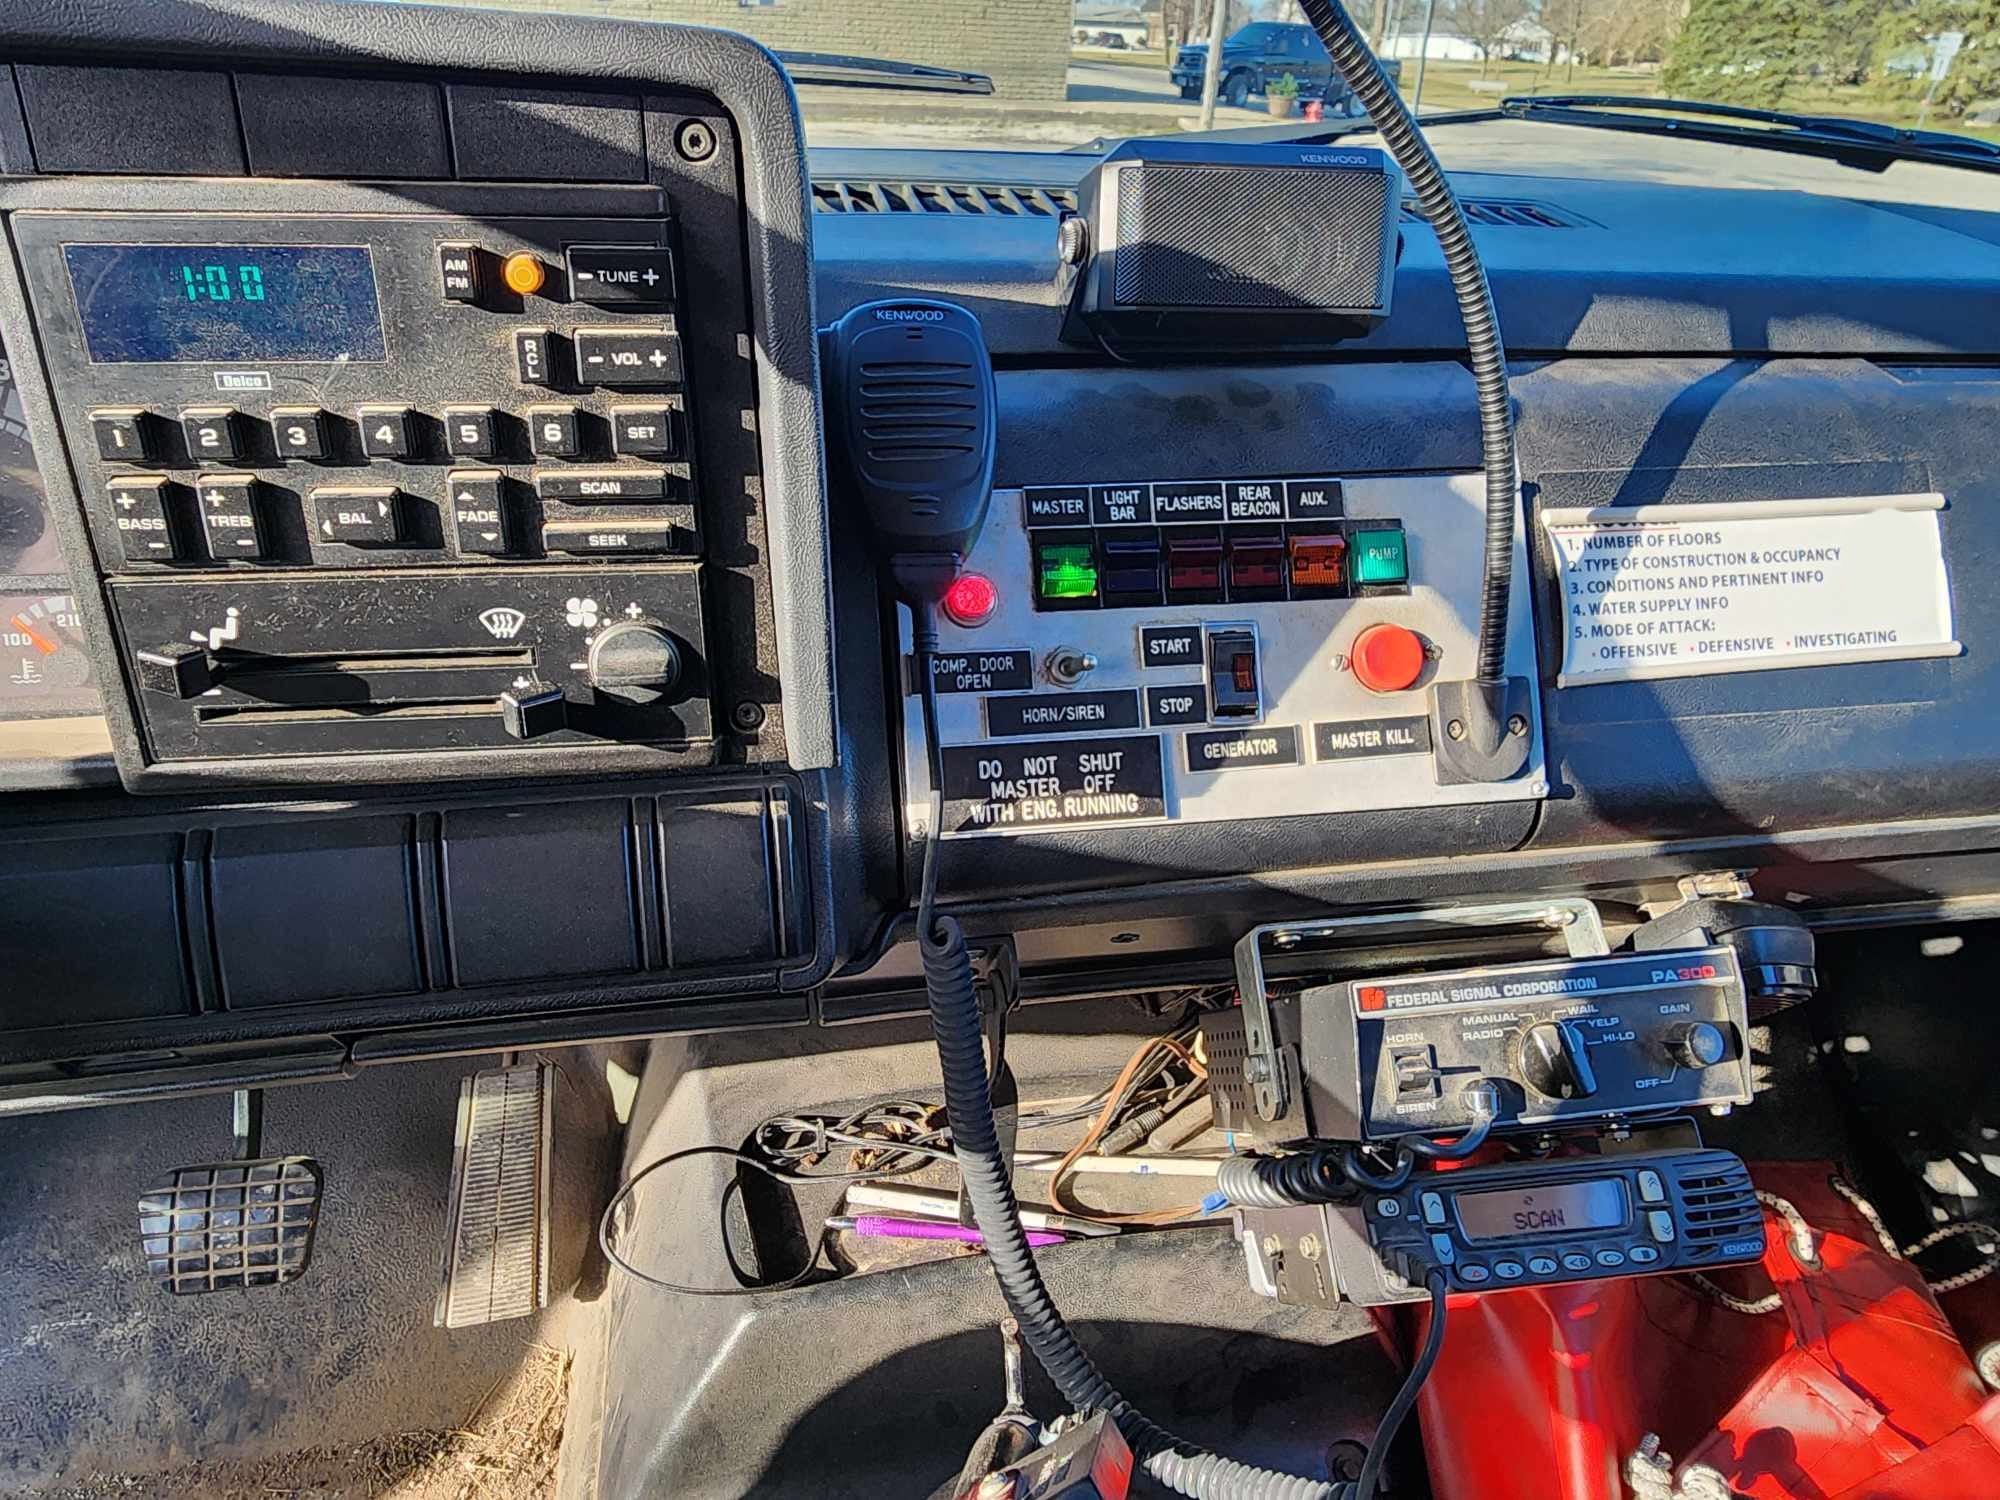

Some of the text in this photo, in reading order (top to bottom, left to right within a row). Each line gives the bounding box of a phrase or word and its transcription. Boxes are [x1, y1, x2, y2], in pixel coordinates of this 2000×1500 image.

[1301, 153, 1367, 165] KENWOOD
[445, 259, 468, 272] AM
[182, 265, 265, 301] 1:00
[447, 276, 469, 289] FM
[597, 269, 639, 283] TUNE
[876, 309, 944, 321] KENWOOD
[610, 352, 643, 366] VOL
[222, 375, 262, 387] Delco
[111, 429, 125, 448] 1
[199, 428, 220, 447] 2
[287, 426, 308, 446] 3
[375, 425, 394, 444] 4
[460, 424, 479, 443] 5
[544, 423, 563, 442] 6
[627, 426, 656, 440] SET
[580, 481, 621, 495] SCAN
[1238, 486, 1272, 501] REAR
[1104, 490, 1141, 506] LIGHT
[1156, 494, 1222, 512] FLASHERS
[1300, 490, 1329, 507] AUX.
[1032, 499, 1085, 516] MASTER
[1110, 504, 1136, 521] BAR
[1231, 499, 1281, 517] BEACON
[117, 518, 166, 531] BASS
[207, 515, 253, 529] TREB
[338, 512, 373, 526] BAL
[457, 510, 499, 523] FADE
[588, 535, 629, 548] SEEK
[1568, 532, 1722, 551] 1. NUMBER OF FLOORS
[1569, 547, 1841, 573] 2. TYPE OF CONSTRUCTION & OCCUPANCY
[1571, 570, 1824, 595] 3. CONDITIONS AND PERTINENT INFO
[1572, 596, 1729, 617] 4. WATER SUPPLY INFO
[1575, 619, 1716, 639] 5. MODE OF ATTACK:
[1150, 638, 1191, 654] START
[1600, 630, 1897, 660] OFFENSIVE DEFENSIVE INVESTIGATING
[979, 655, 1014, 672] DOOR
[956, 674, 992, 689] OPEN
[1160, 697, 1193, 714] STOP
[1022, 704, 1105, 724] HORN/SIREN
[1331, 728, 1415, 749] MASTER KILL
[1203, 738, 1278, 760] GENERATOR
[978, 751, 1123, 780] DO NOT SHUT
[991, 774, 1116, 800] MASTER OFF
[970, 793, 1139, 824] WITH ENG. RUNNING
[1651, 965, 1716, 983] PA300
[1387, 976, 1597, 1009] FEDERAL SIGNAL CORPORATION
[1568, 1005, 1599, 1015] WAIL
[1659, 1003, 1691, 1015] GAIN
[1462, 1012, 1519, 1026] MANUAL
[1587, 1017, 1620, 1028] YELP
[1386, 1032, 1425, 1044] HORN
[1462, 1028, 1504, 1041] RADIO
[1602, 1031, 1636, 1042] HI-LO
[1635, 1079, 1660, 1089] OFF
[1396, 1102, 1437, 1115] SIREN
[1513, 1209, 1566, 1230] SCAN
[1507, 1265, 1516, 1276] S
[1541, 1261, 1551, 1271] A
